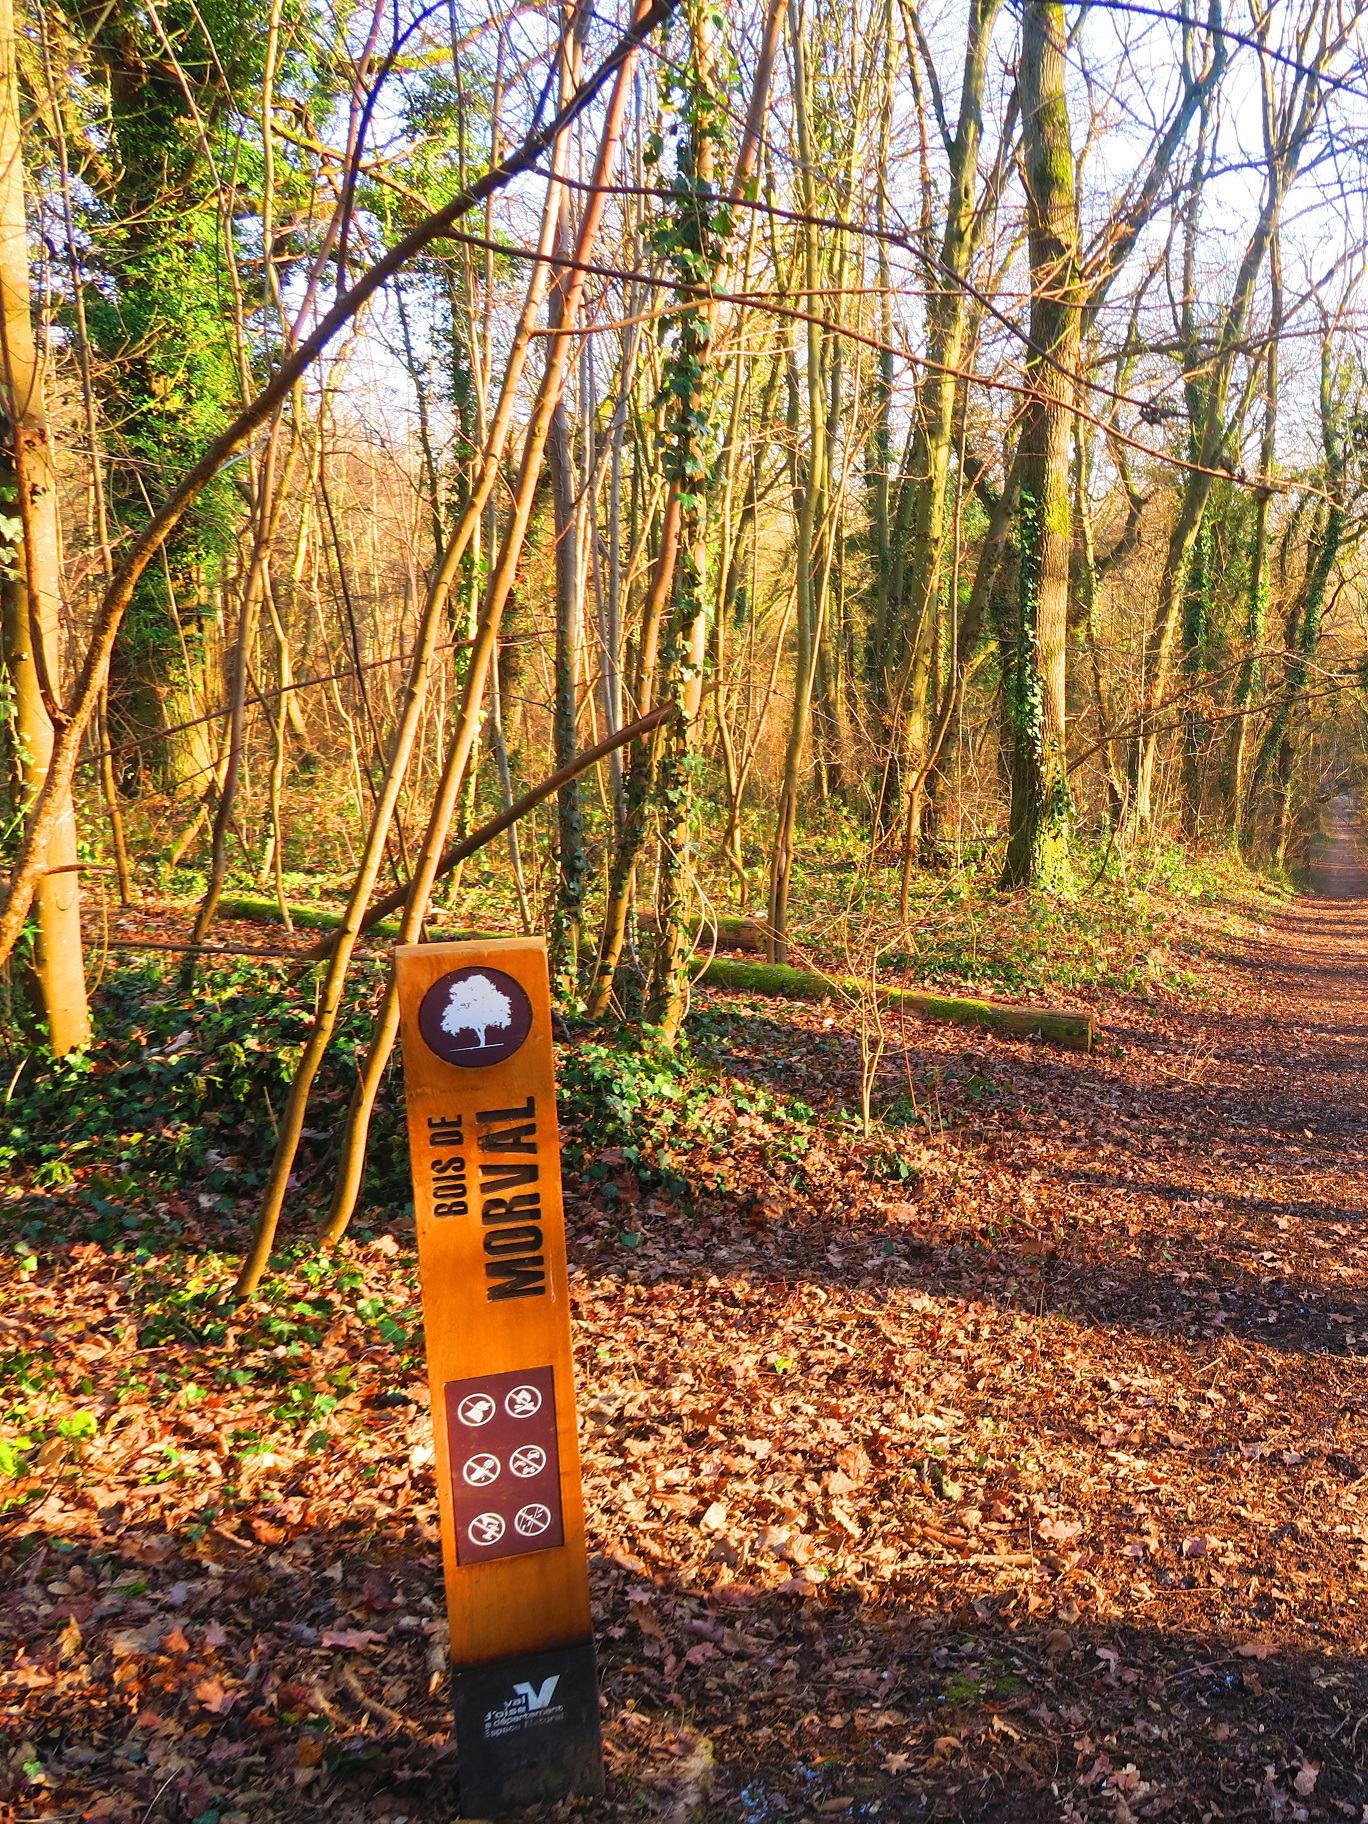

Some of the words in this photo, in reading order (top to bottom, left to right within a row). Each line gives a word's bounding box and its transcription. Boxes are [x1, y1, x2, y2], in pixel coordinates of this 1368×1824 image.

[427, 1113, 464, 1148] DE
[431, 1156, 469, 1218] BOIS
[475, 1095, 546, 1303] MORVAL
[503, 1694, 526, 1708] val
